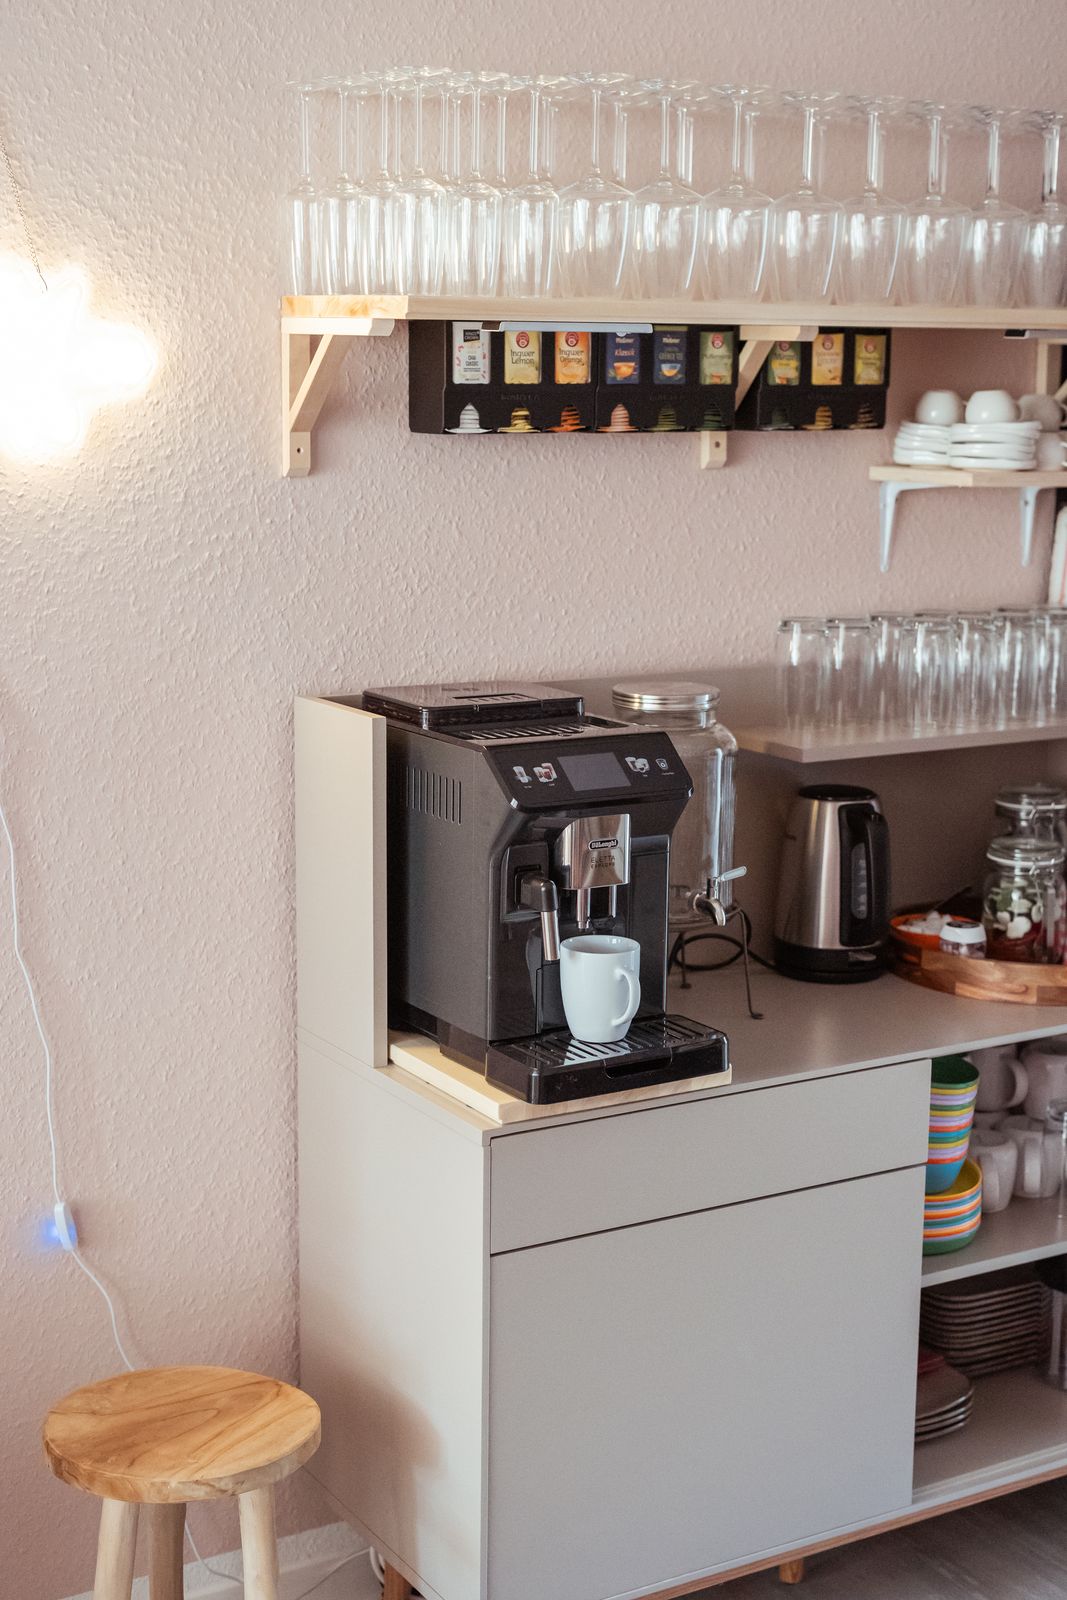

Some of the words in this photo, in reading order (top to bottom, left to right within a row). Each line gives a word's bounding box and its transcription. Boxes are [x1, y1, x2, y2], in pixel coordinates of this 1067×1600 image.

[510, 349, 535, 359] Ingwer
[559, 348, 584, 358] Ingwer
[511, 358, 534, 366] Lemon
[560, 356, 583, 365] Orange
